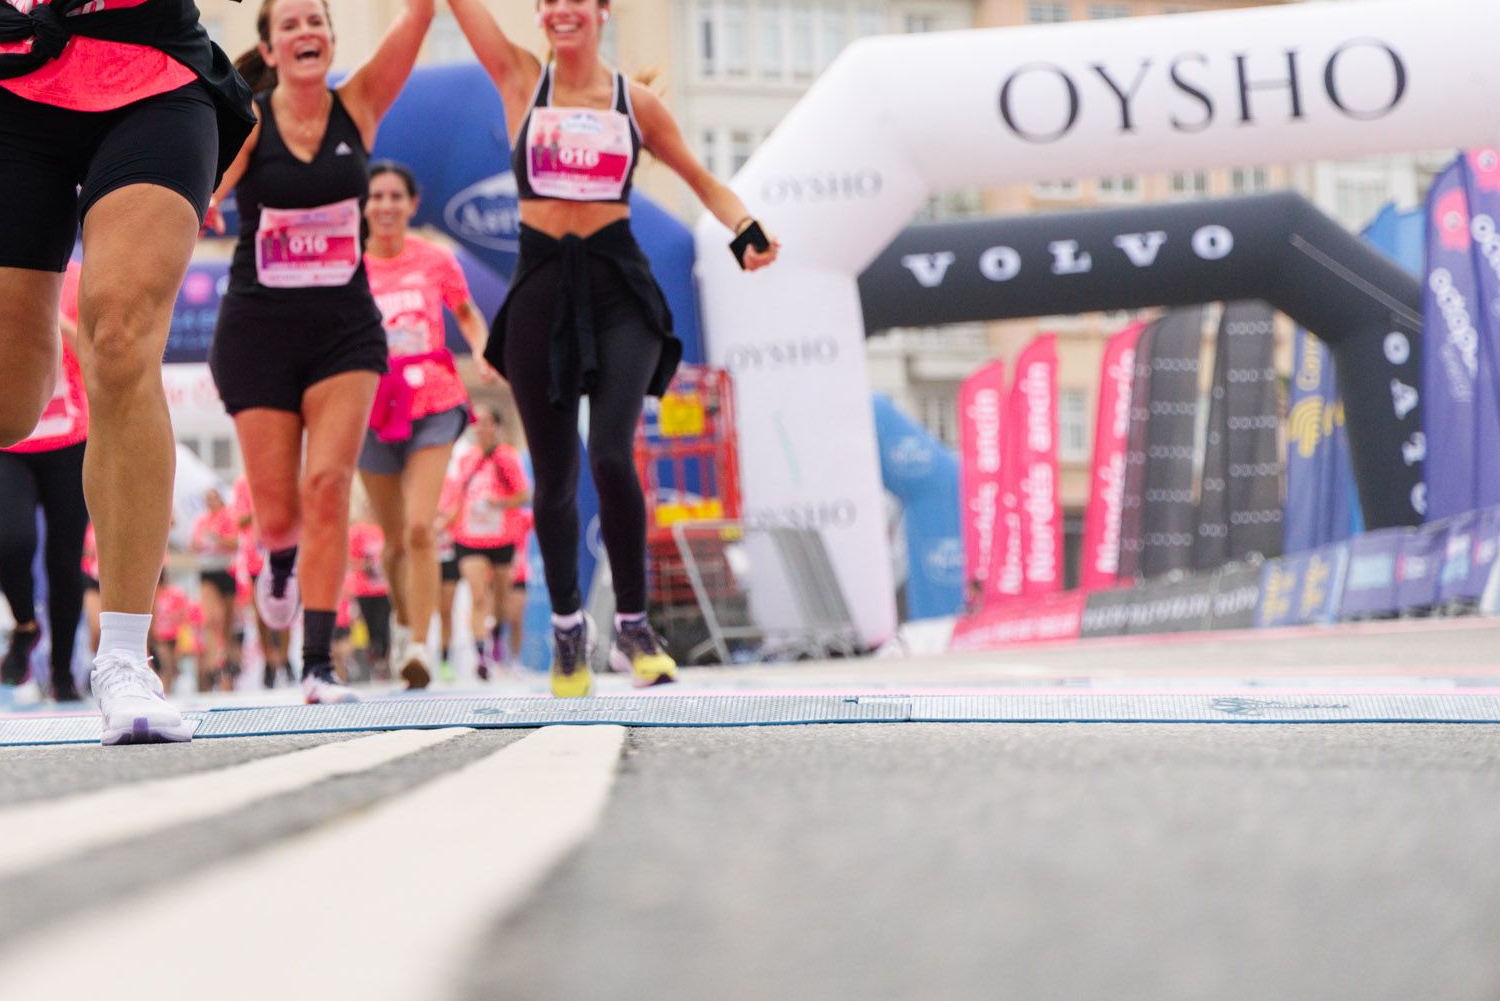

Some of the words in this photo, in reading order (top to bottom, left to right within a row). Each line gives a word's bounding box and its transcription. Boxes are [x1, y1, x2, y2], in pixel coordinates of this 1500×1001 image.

[998, 38, 1409, 143] OYSHO
[559, 146, 600, 168] 016
[760, 167, 883, 206] OYSHO
[288, 236, 329, 254] 016
[904, 224, 1234, 288] VOLVO
[725, 333, 839, 372] OYSHO
